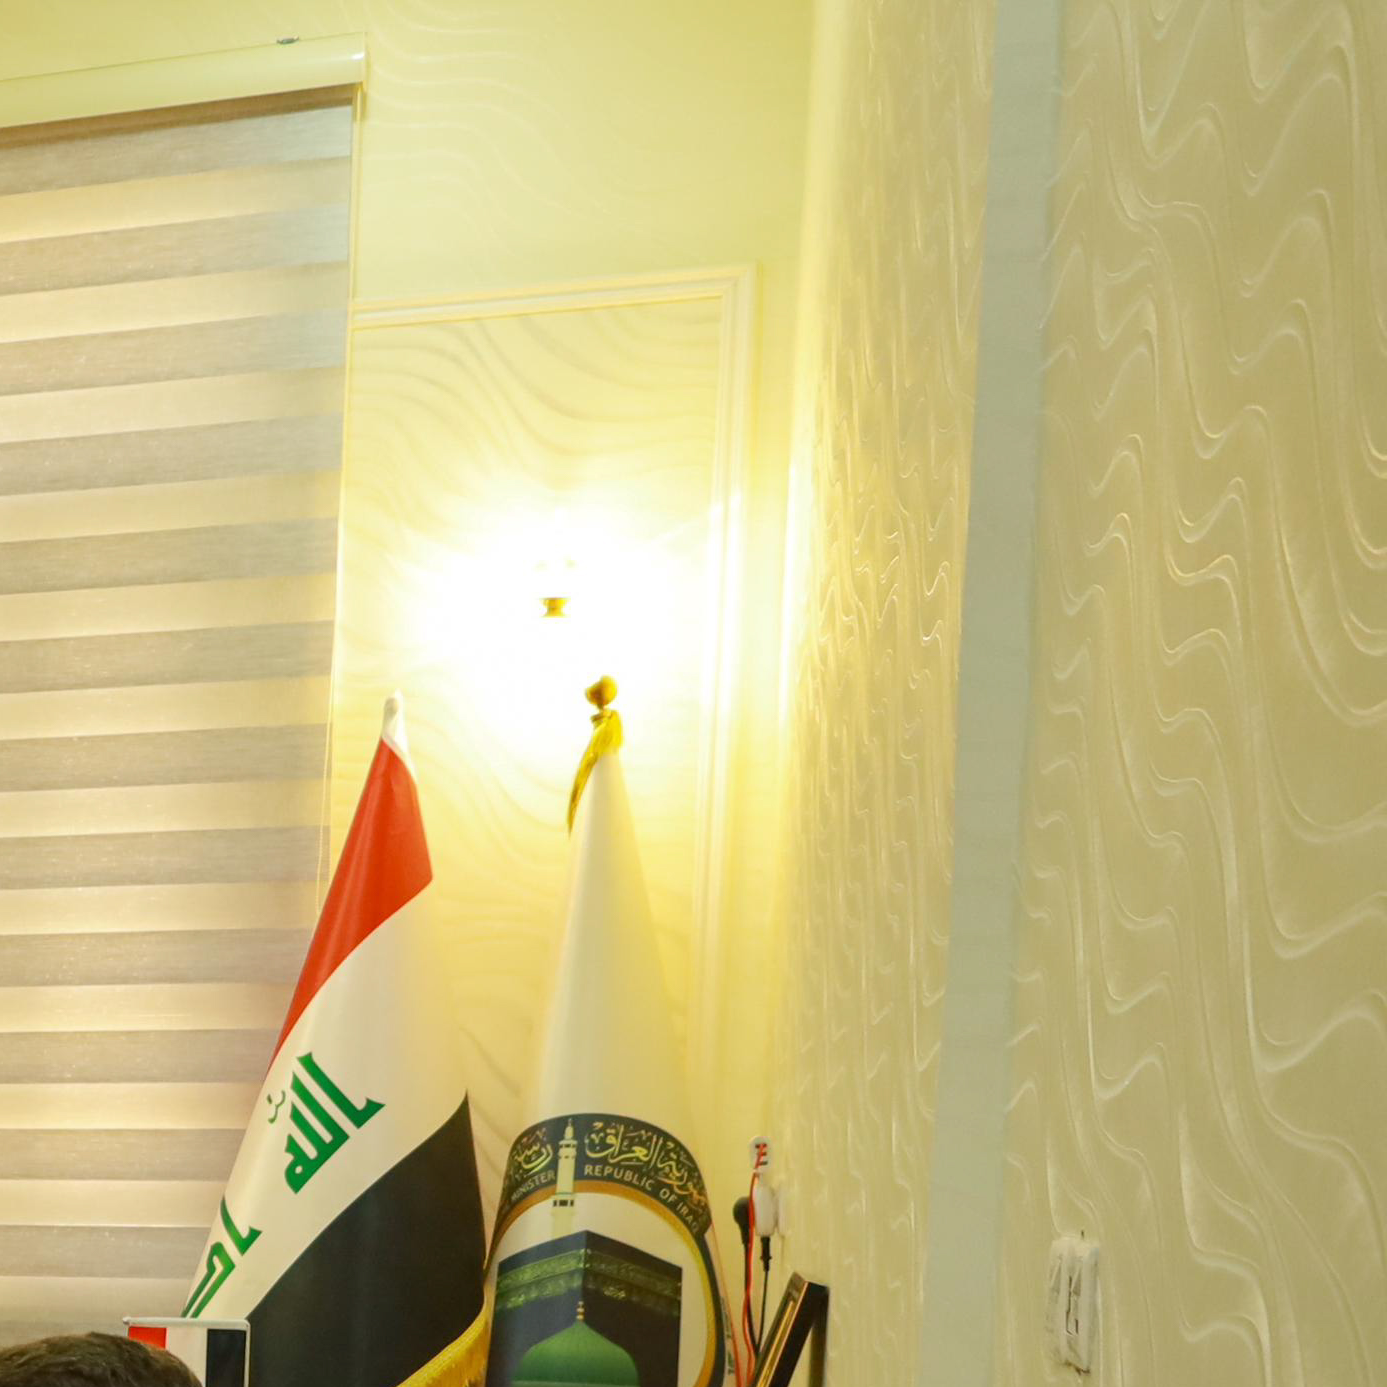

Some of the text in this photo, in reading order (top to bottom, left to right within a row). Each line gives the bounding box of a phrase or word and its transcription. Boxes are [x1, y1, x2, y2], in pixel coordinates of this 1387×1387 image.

[284, 1051, 386, 1195] الله
[584, 1164, 655, 1191] REPUBLIC
[658, 1187, 677, 1204] OF
